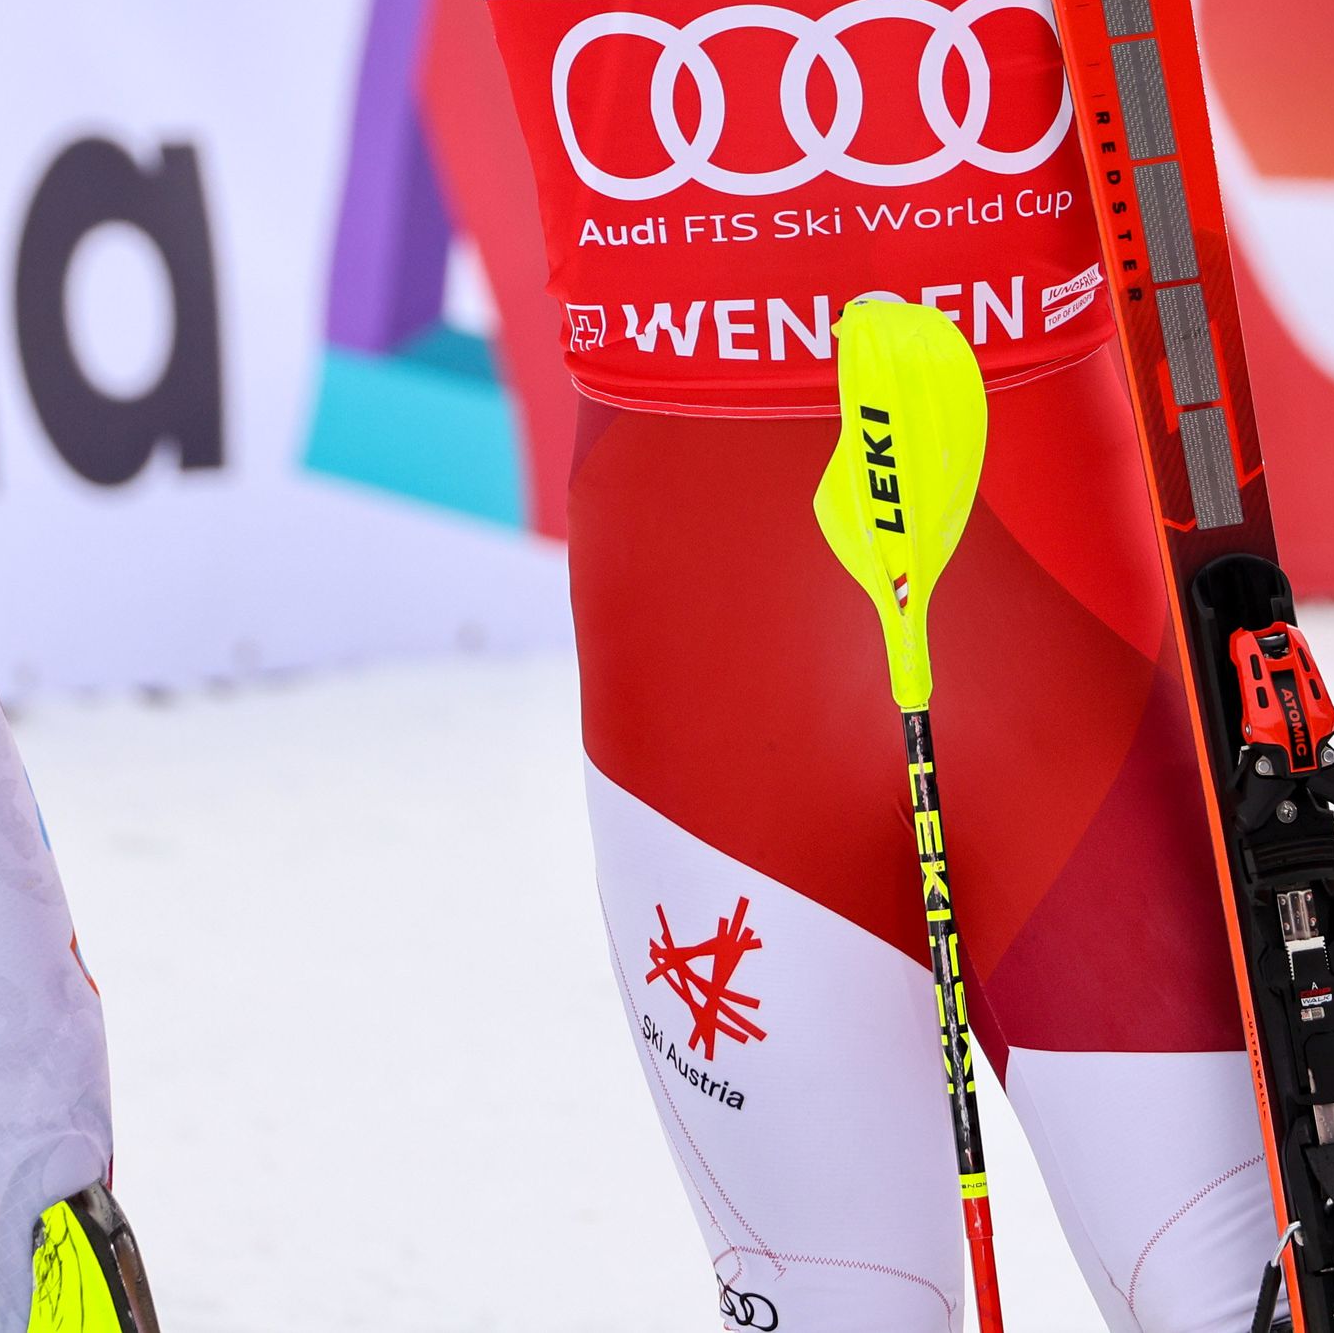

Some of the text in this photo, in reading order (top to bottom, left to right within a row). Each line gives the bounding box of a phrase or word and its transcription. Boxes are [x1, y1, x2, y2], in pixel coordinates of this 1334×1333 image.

[578, 189, 1073, 247] Audi FIS Ski World Cup
[1095, 110, 1142, 304] REDSTER
[1048, 269, 1098, 301] JUNGFRAU
[1048, 293, 1093, 326] TOP OF EUROPE
[860, 405, 906, 534] LEKI
[1280, 687, 1309, 758] ATOMIC
[642, 1014, 745, 1110] Ski Austria
